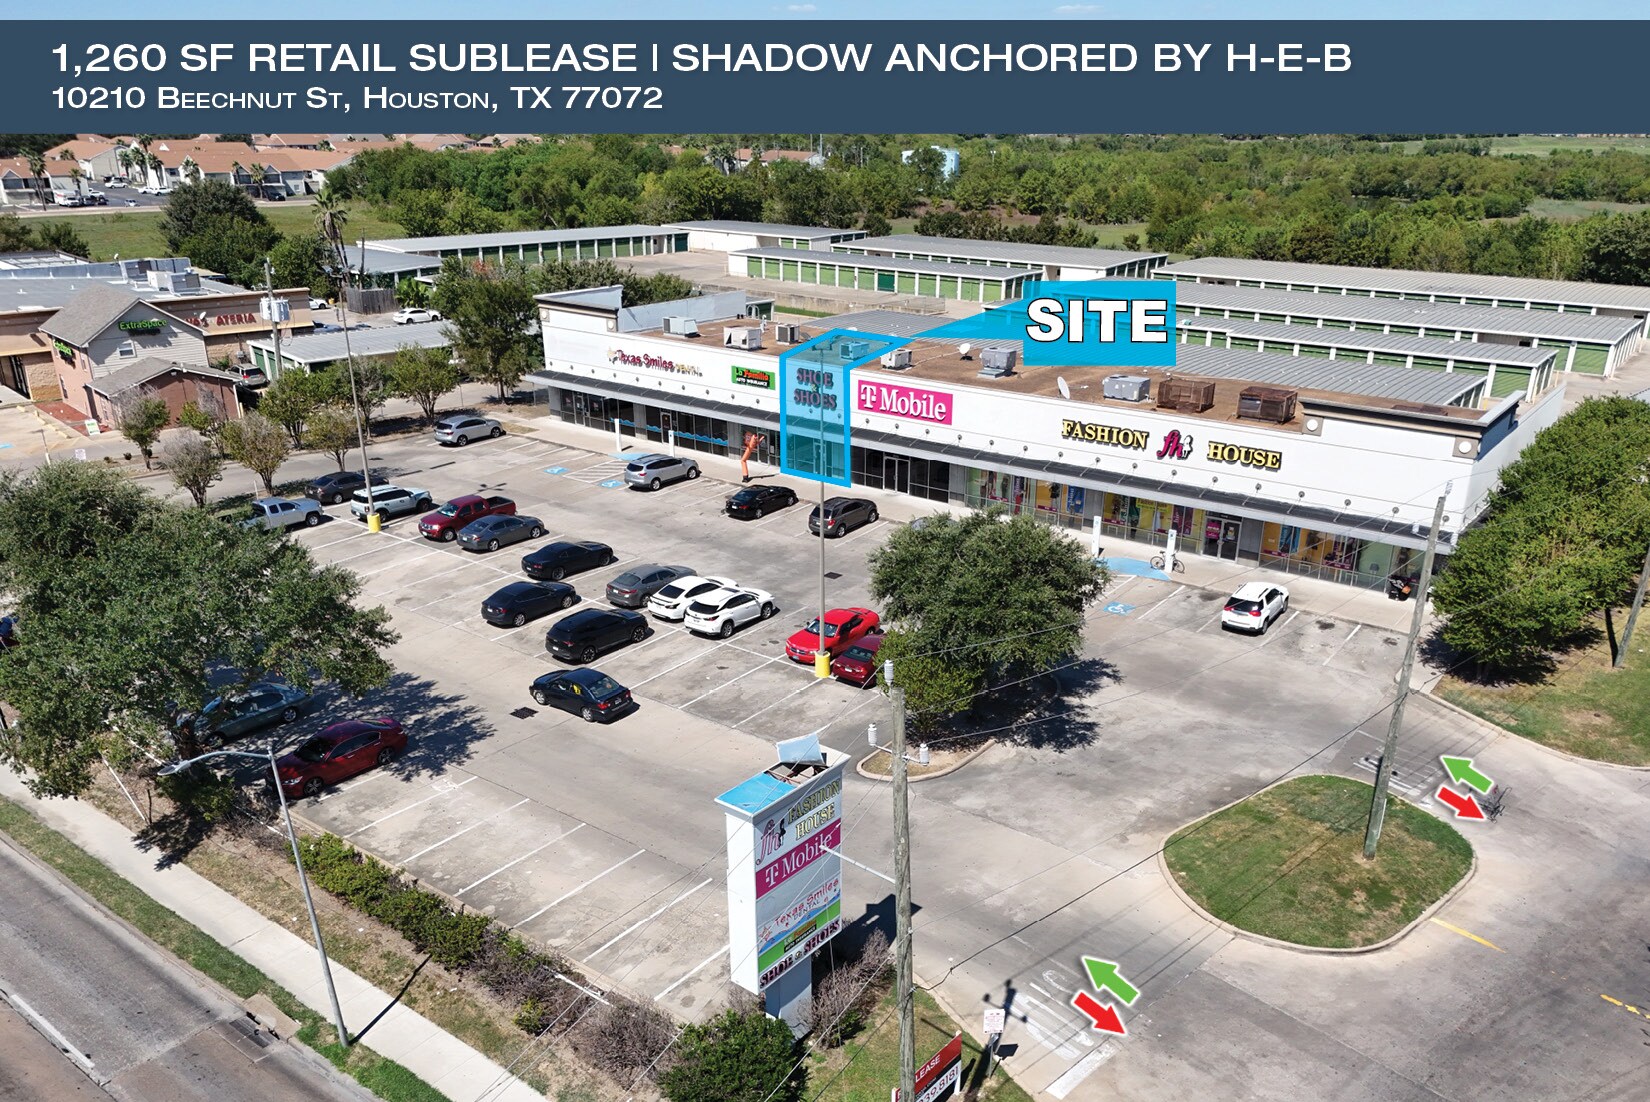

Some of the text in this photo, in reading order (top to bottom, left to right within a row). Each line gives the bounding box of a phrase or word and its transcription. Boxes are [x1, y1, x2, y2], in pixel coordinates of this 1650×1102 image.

[615, 349, 641, 365] Texas
[643, 353, 675, 370] Smiles
[797, 367, 833, 388] SHOE
[794, 388, 837, 410] SHOES
[879, 387, 947, 421] Mobile
[1061, 418, 1149, 450] FASHION
[1207, 440, 1282, 472] HOUSE
[788, 779, 840, 824] FASHION
[796, 802, 835, 840] HOUSE
[782, 833, 832, 879] Mobile
[775, 879, 839, 926] Texas Smiles
[760, 954, 793, 988] SHOE
[804, 919, 840, 955] SHOES
[915, 1055, 940, 1082] LEASE
